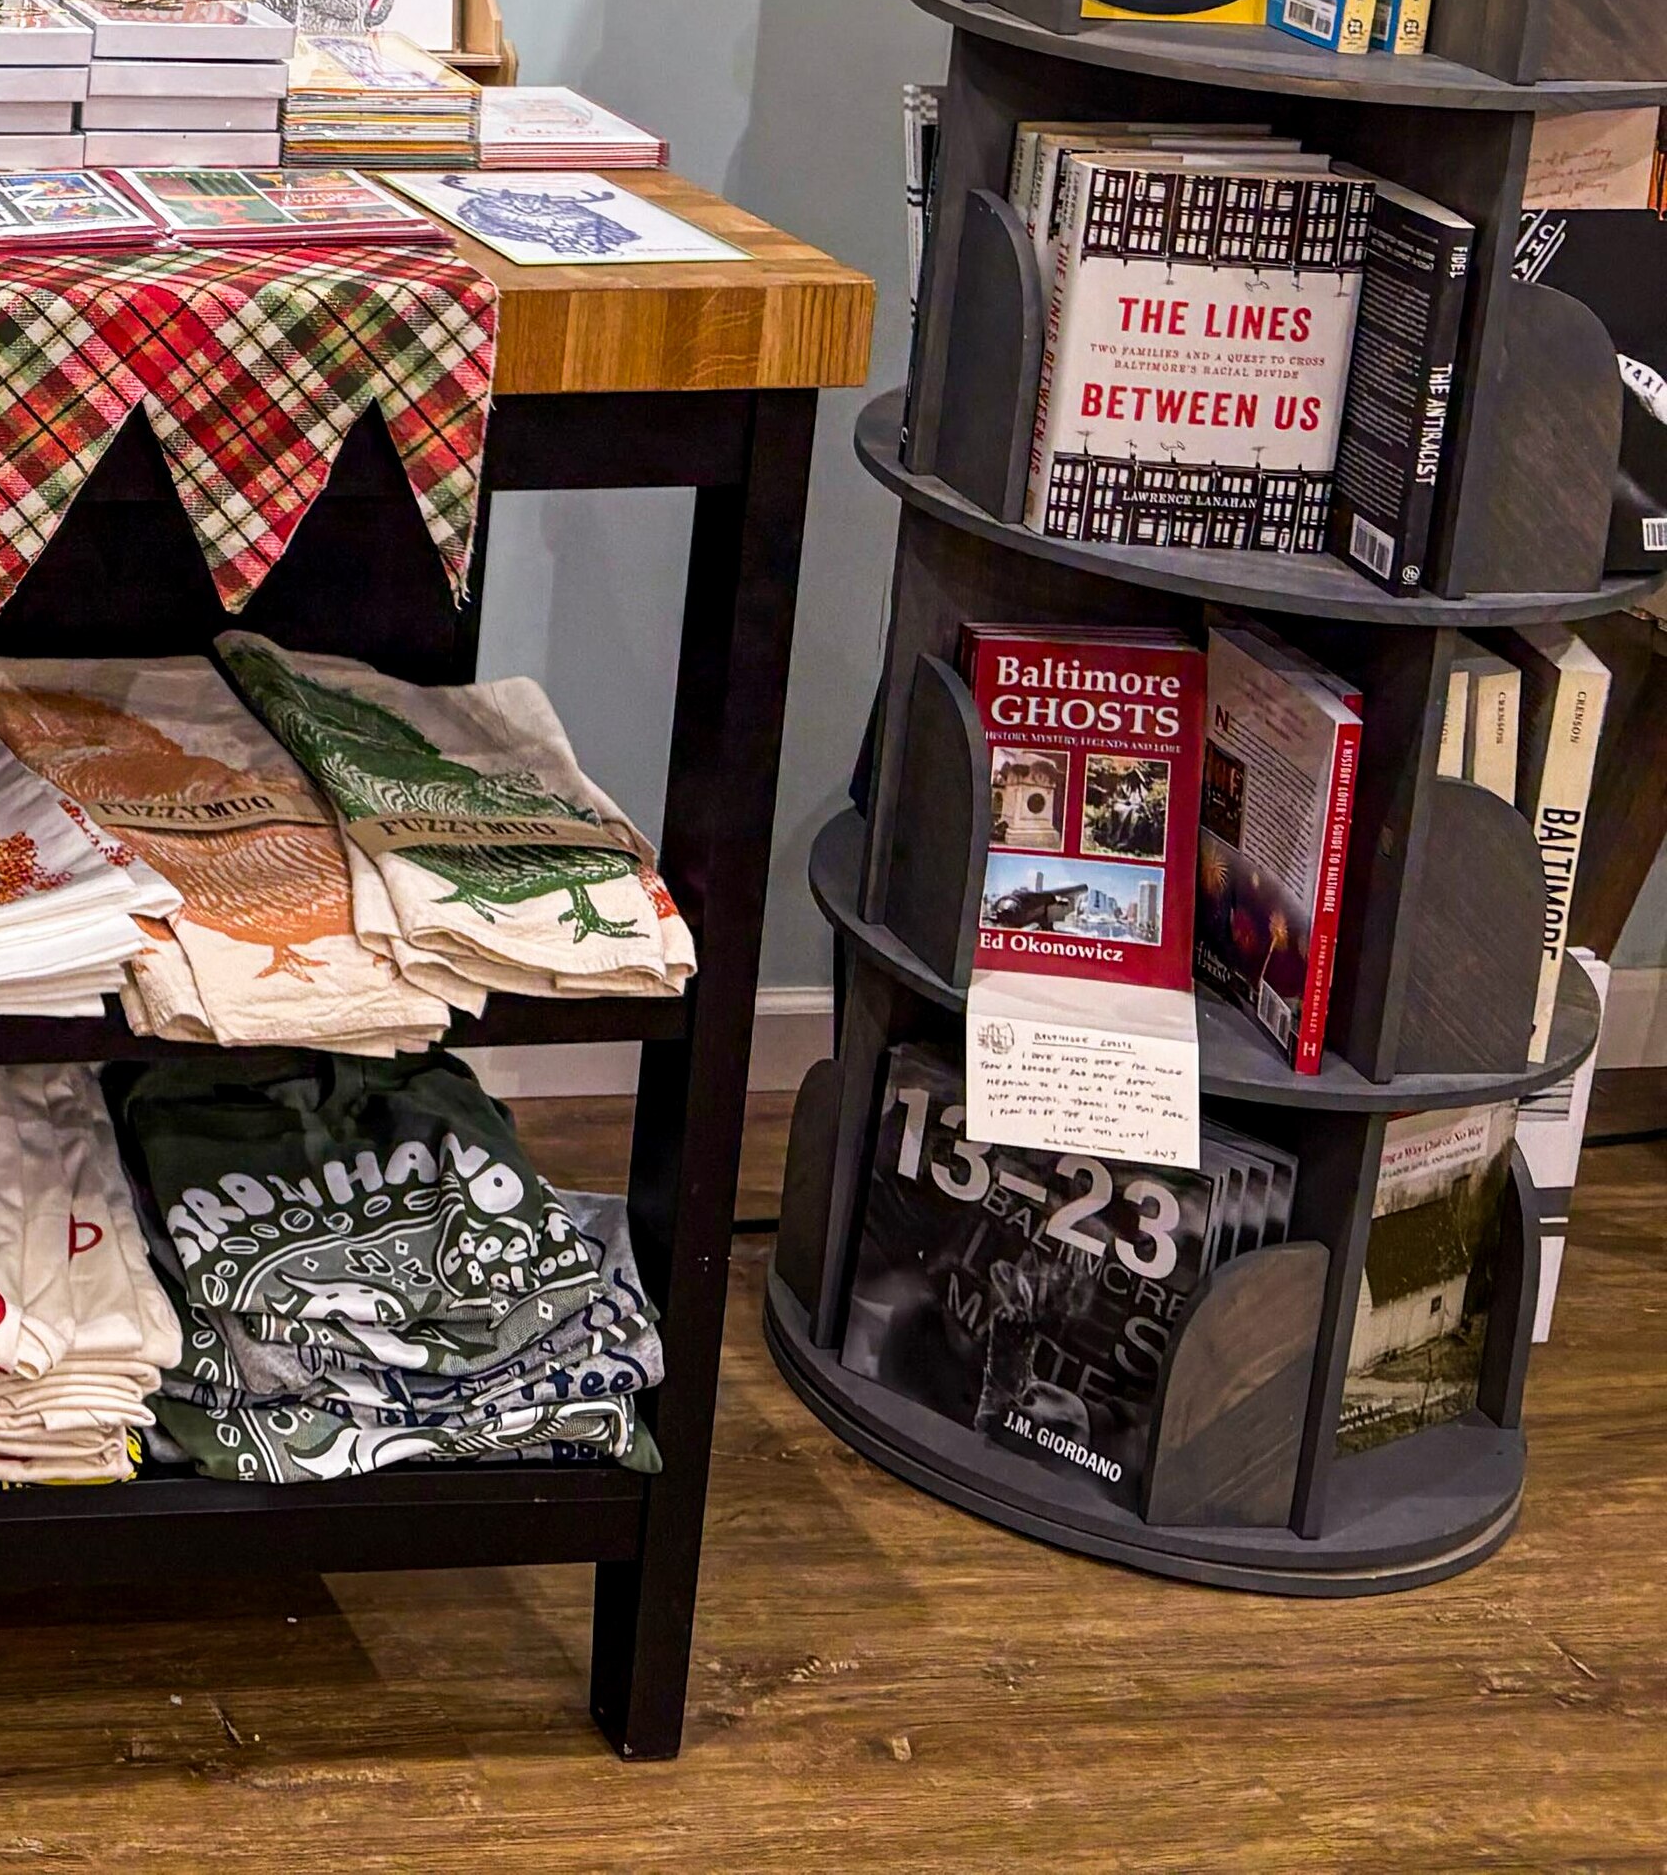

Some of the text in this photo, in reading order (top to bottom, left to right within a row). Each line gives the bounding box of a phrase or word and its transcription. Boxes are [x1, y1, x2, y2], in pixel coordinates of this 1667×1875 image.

[1118, 296, 1312, 343] THE LINES
[1090, 343, 1326, 367] TWO FAMILIES AND A QUEST TO CROSS
[1080, 383, 1322, 432] BETWEEN US
[1414, 362, 1454, 488] THE ANTIRACIST
[1122, 490, 1257, 509] LAWRENCE LANAHAN
[995, 655, 1182, 700] Baltimore
[990, 692, 1182, 737] GHOSTS
[1130, 741, 1154, 752] AND
[1331, 824, 1342, 853] GUIDE
[1328, 855, 1338, 866] TO
[979, 931, 1125, 964] Ed Okonowicz
[1003, 1410, 1123, 1483] J.M. GIORDANO
